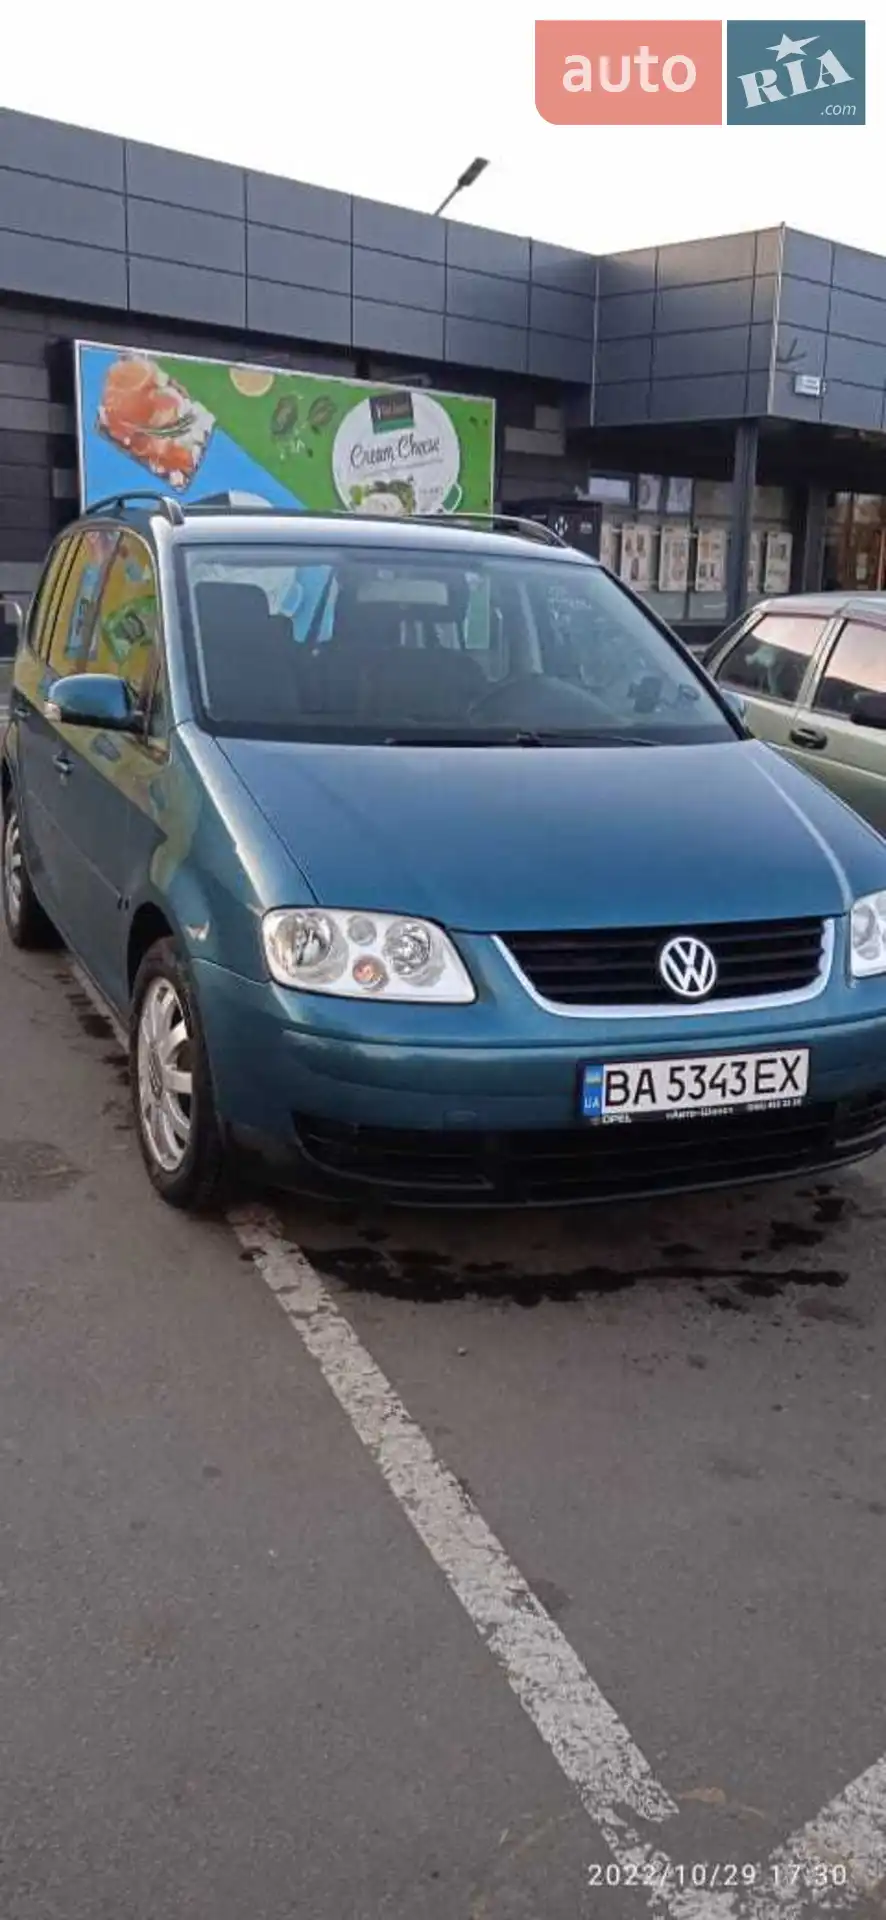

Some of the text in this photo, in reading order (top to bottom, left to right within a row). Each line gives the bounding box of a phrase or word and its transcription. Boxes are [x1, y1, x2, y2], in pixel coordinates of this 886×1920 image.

[350, 432, 440, 469] Cream Cheese
[605, 1068, 656, 1107] BA
[666, 1060, 748, 1102] 5343
[584, 1096, 600, 1109] UA
